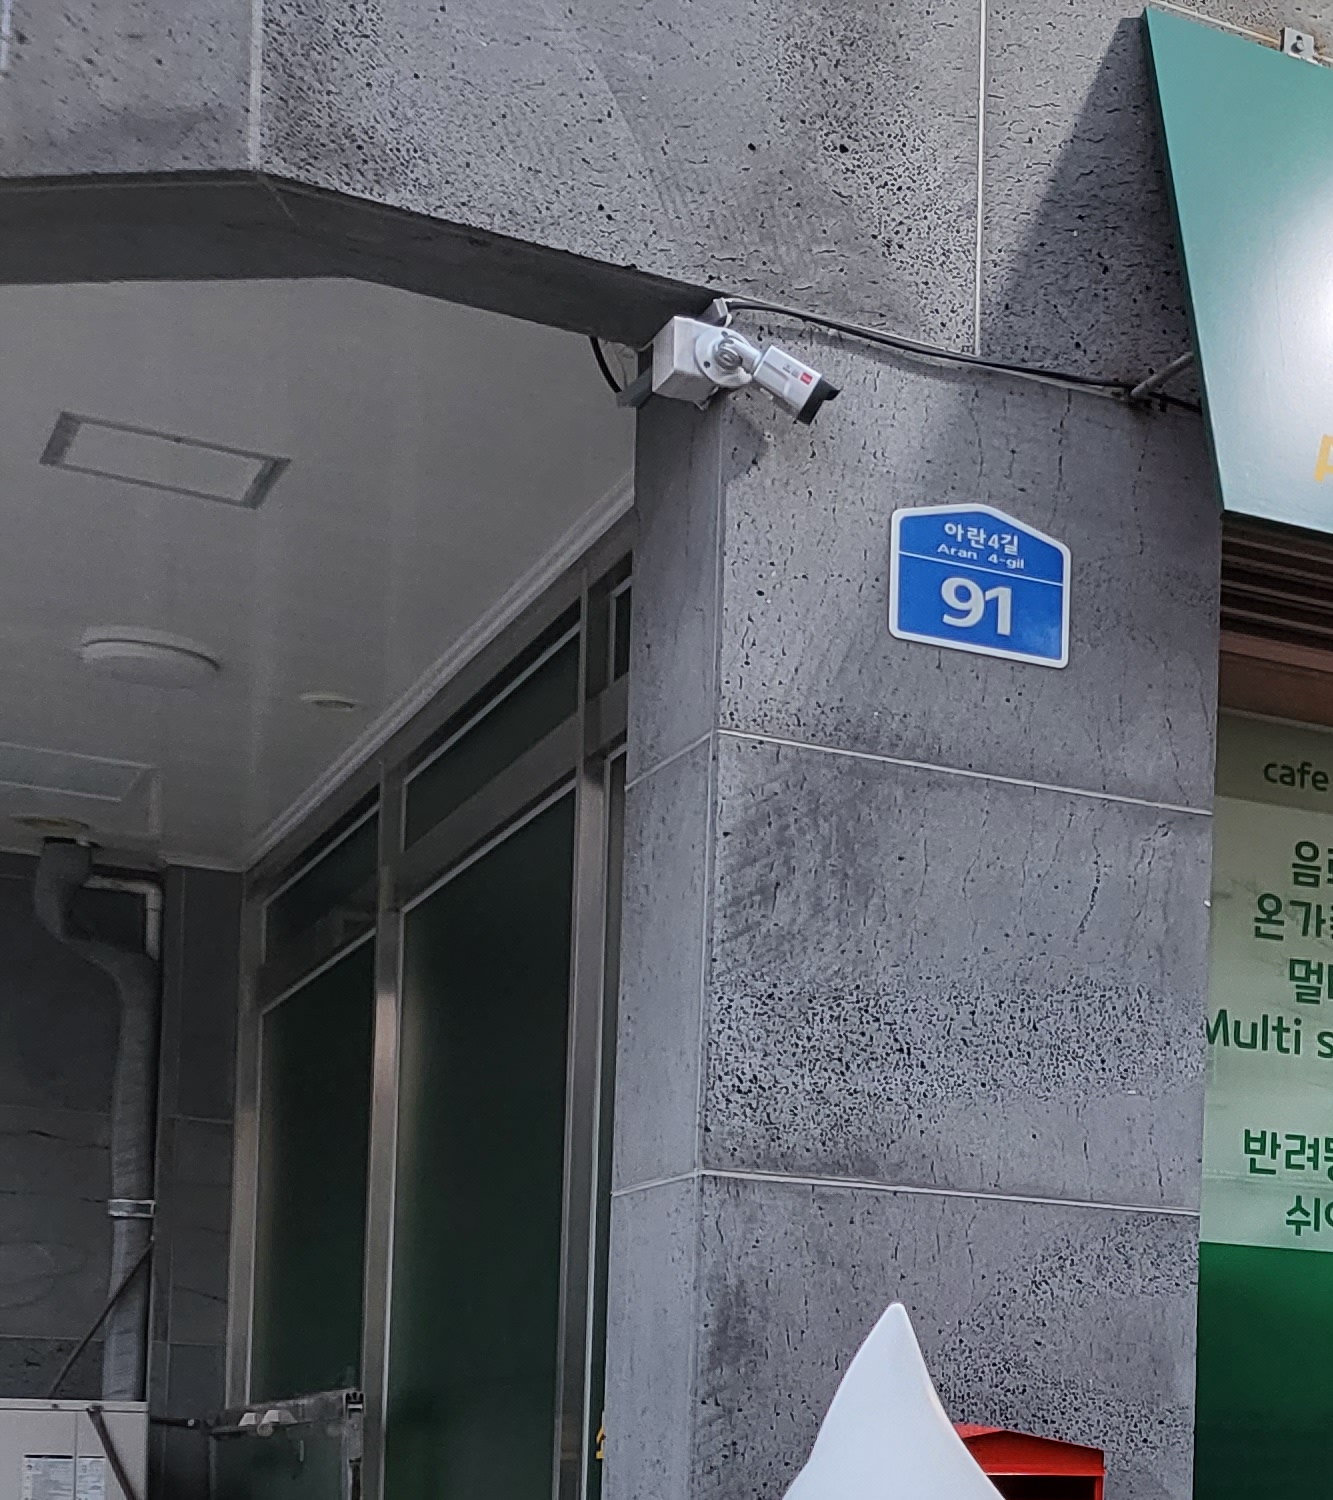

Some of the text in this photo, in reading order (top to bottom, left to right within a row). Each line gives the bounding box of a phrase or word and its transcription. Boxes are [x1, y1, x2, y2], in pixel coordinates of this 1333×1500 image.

[944, 522, 1019, 556] 아란4길
[937, 543, 1025, 570] Aran 4-gil
[941, 577, 1012, 637] 91
[1263, 759, 1330, 791] cafe
